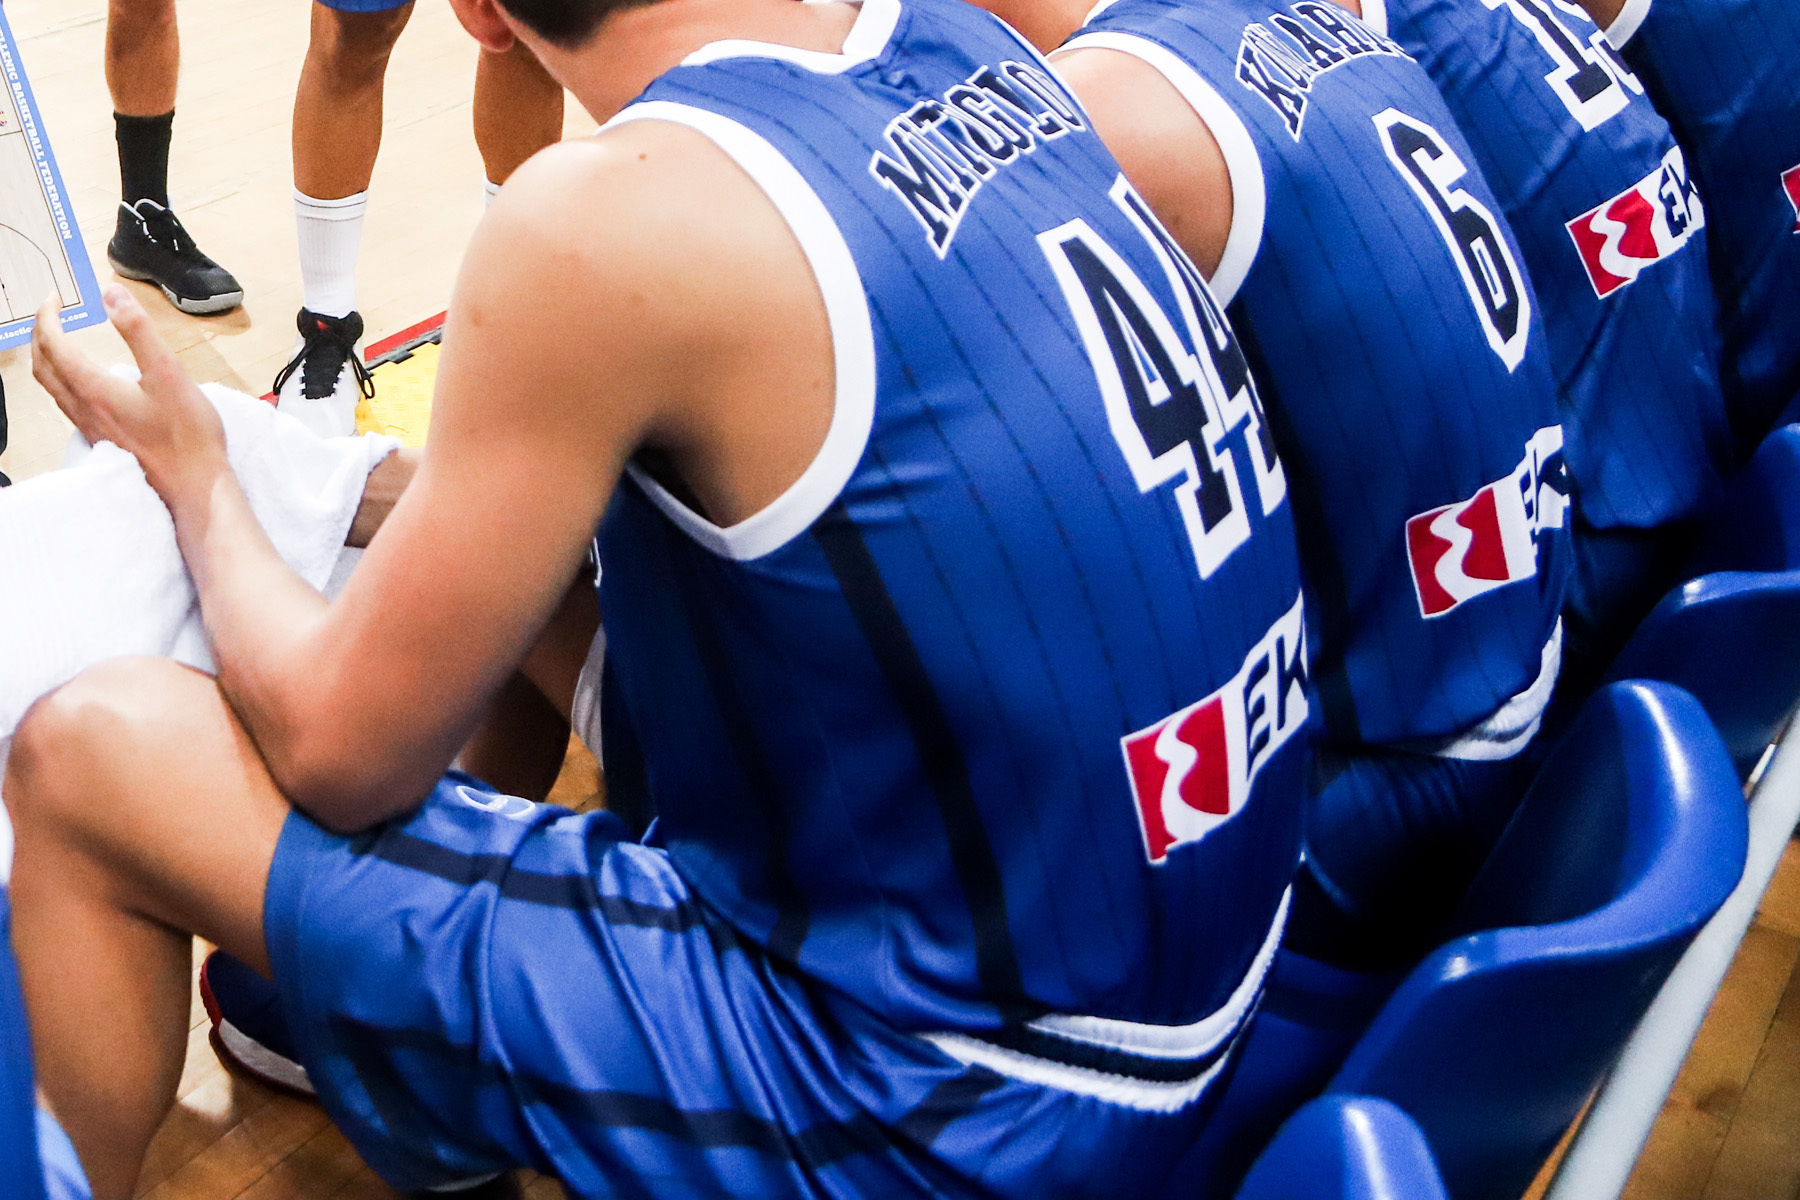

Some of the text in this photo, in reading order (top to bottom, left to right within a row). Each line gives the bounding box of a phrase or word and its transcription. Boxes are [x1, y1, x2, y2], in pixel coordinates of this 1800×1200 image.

[11, 80, 45, 161] BASKETBALL
[38, 159, 73, 241] FEDERATION
[1372, 106, 1530, 373] 6
[1036, 171, 1288, 581] 44
